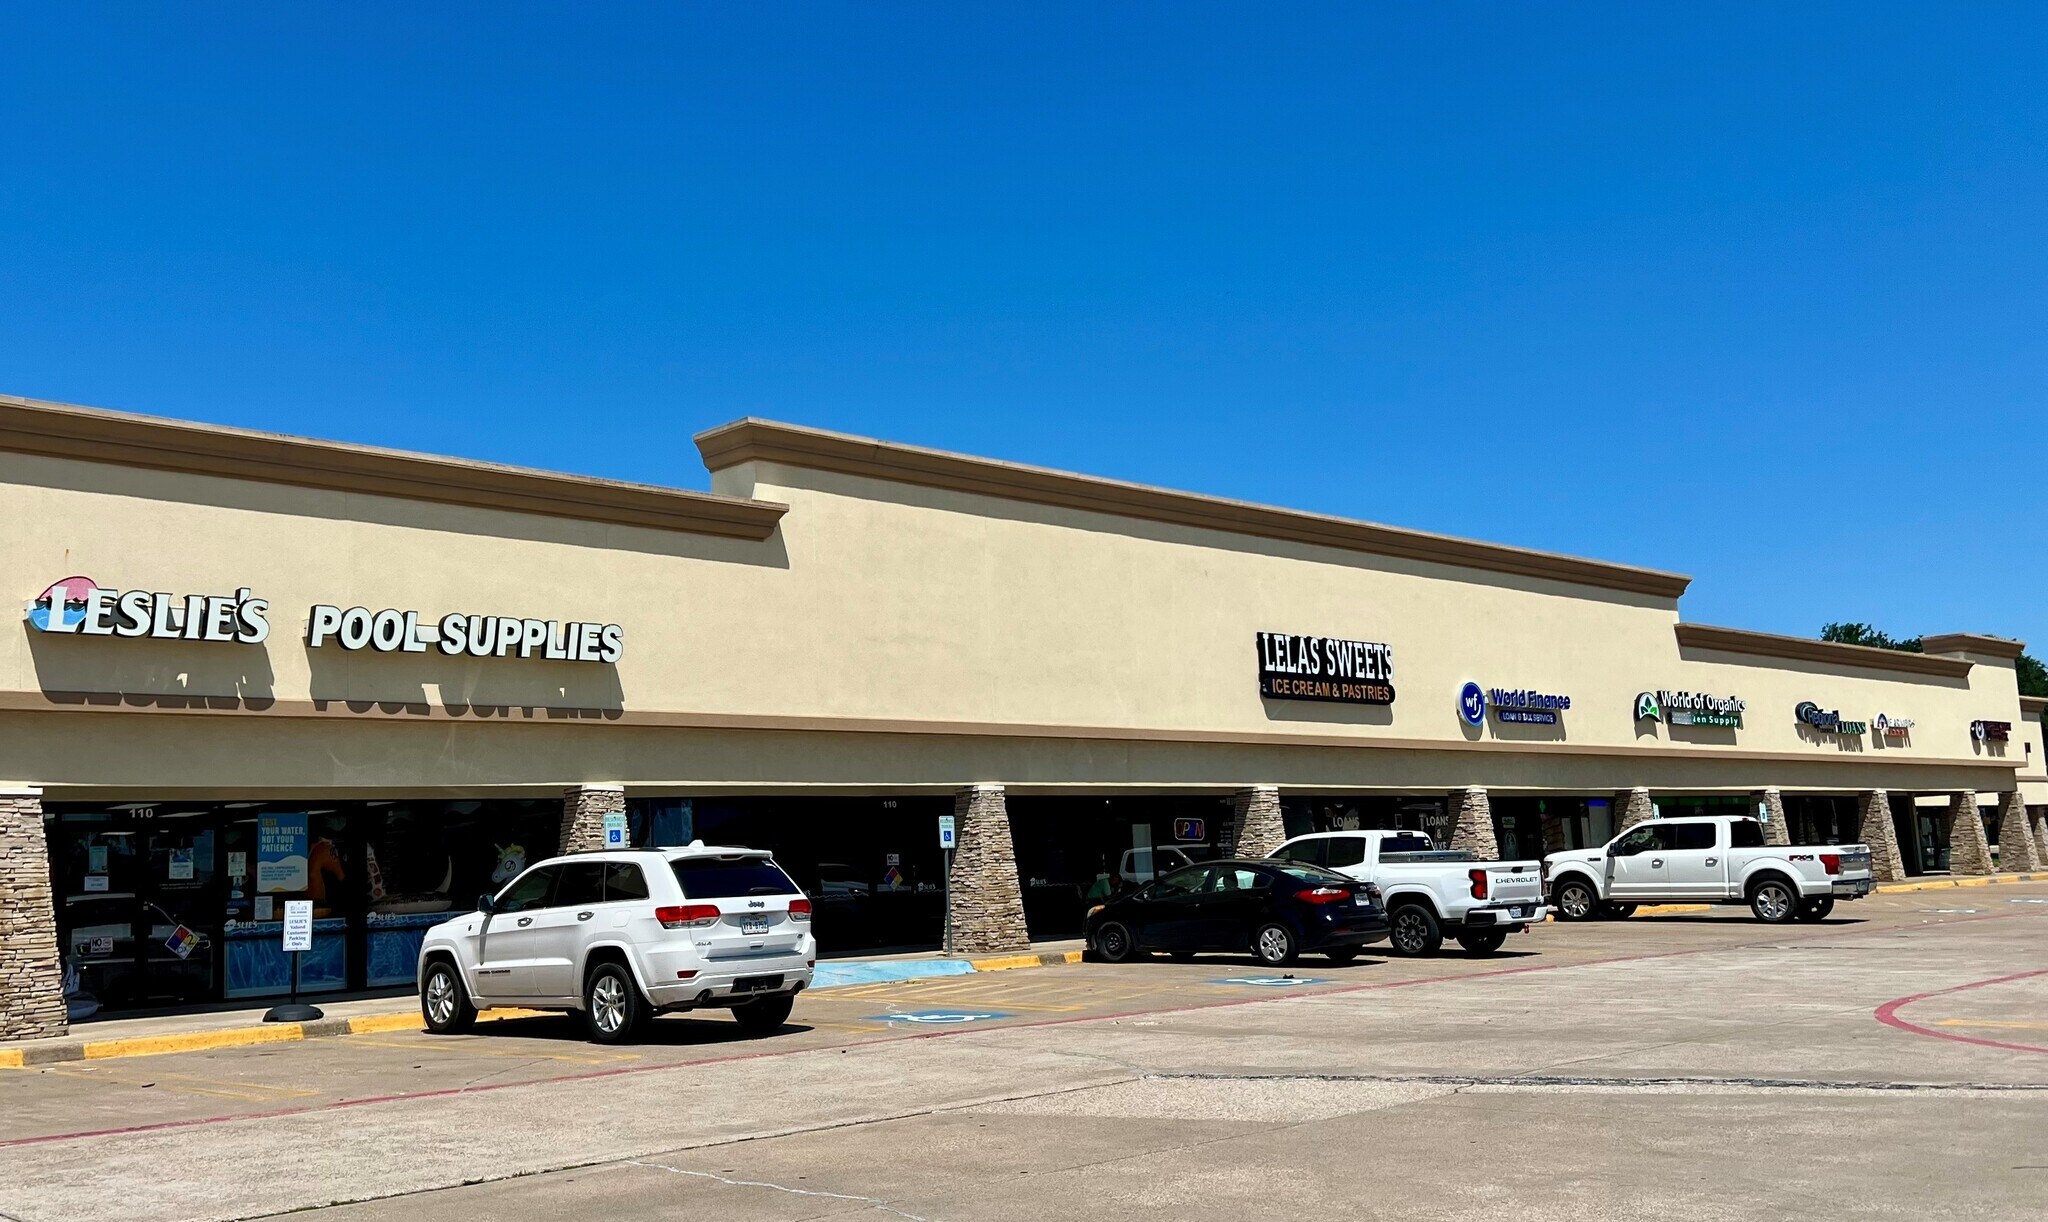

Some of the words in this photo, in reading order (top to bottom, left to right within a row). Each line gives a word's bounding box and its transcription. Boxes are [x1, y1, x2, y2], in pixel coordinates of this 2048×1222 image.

[46, 586, 270, 644] LESLIE'S
[310, 604, 427, 652] POOL
[437, 612, 624, 663] SUPPLIES
[1263, 633, 1321, 675] LELAS
[1325, 639, 1393, 680] SWEETS
[1272, 678, 1290, 694] ICE
[1292, 679, 1330, 697] CREAM
[1332, 683, 1340, 698] &
[1342, 683, 1390, 701] PASTRIES
[1491, 688, 1526, 707] World
[1527, 690, 1571, 710] Finance
[1660, 690, 1692, 709] World
[1694, 693, 1705, 710] of
[1706, 694, 1746, 716] Organics
[1502, 712, 1517, 721] LOAN
[1533, 713, 1554, 723] SERVICE
[1708, 715, 1739, 727] Supply
[1841, 721, 1866, 735] LOANS
[129, 808, 154, 819] 110
[261, 826, 280, 835] YOUR
[281, 826, 306, 836] WATER,
[261, 835, 275, 844] NOT
[276, 835, 295, 844] YOUR
[261, 843, 294, 852] PATIENCE
[1495, 876, 1538, 884] CHEVROLET
